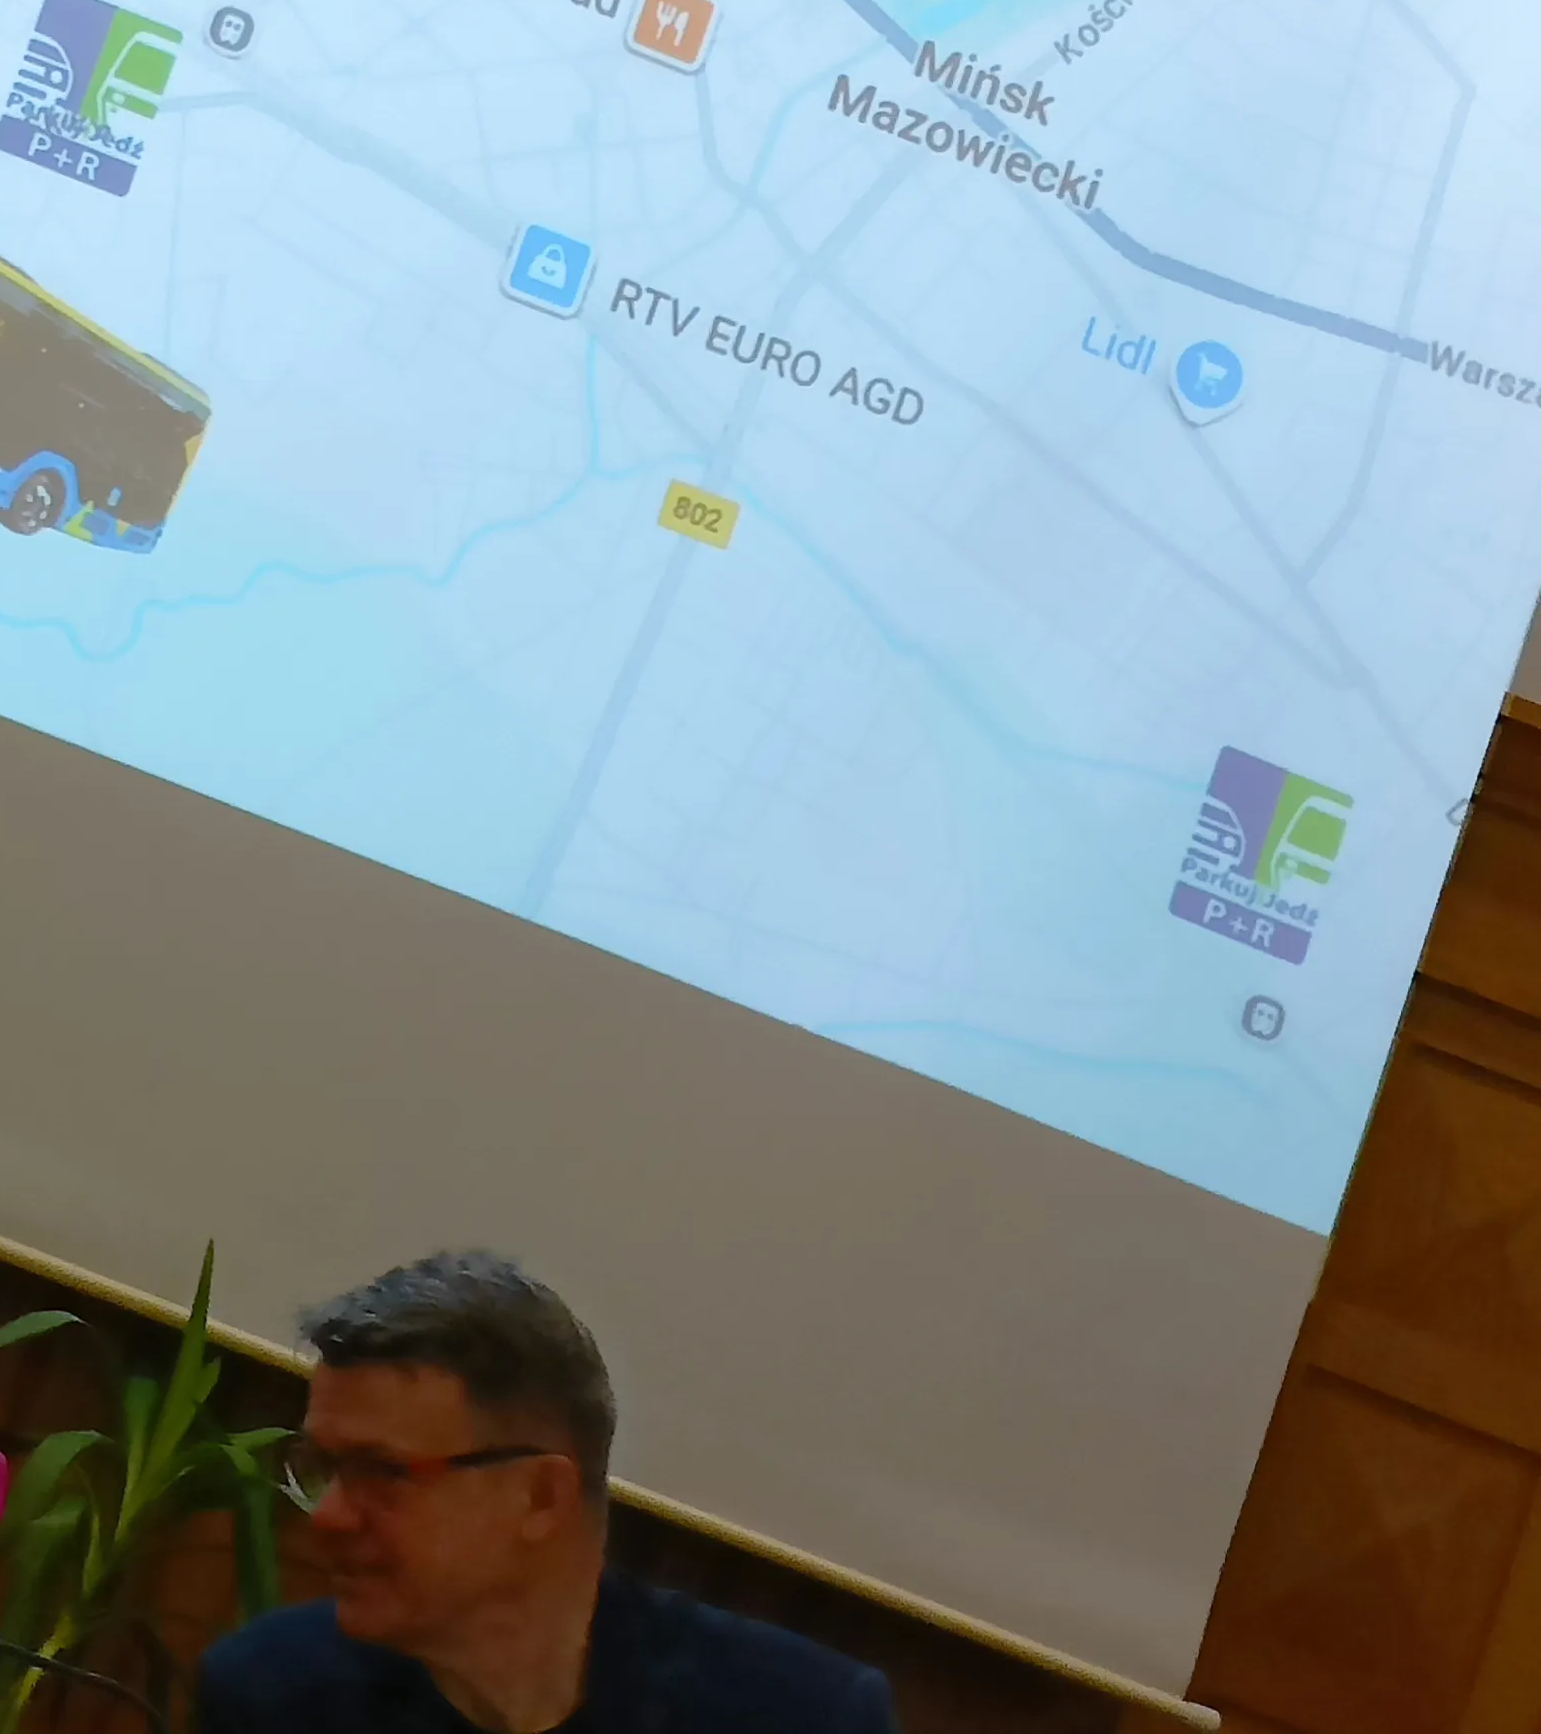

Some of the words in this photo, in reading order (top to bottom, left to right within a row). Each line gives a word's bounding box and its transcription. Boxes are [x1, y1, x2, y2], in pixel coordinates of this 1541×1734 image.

[914, 41, 1056, 127] Mińsk
[28, 132, 99, 181] P+R
[827, 74, 1104, 210] Mazowiecki
[610, 279, 698, 338] RTV
[705, 317, 821, 388] EURO
[830, 367, 925, 426] AGD
[1082, 316, 1156, 374] Lidl
[673, 495, 724, 535] 802
[1203, 899, 1275, 948] P+R
